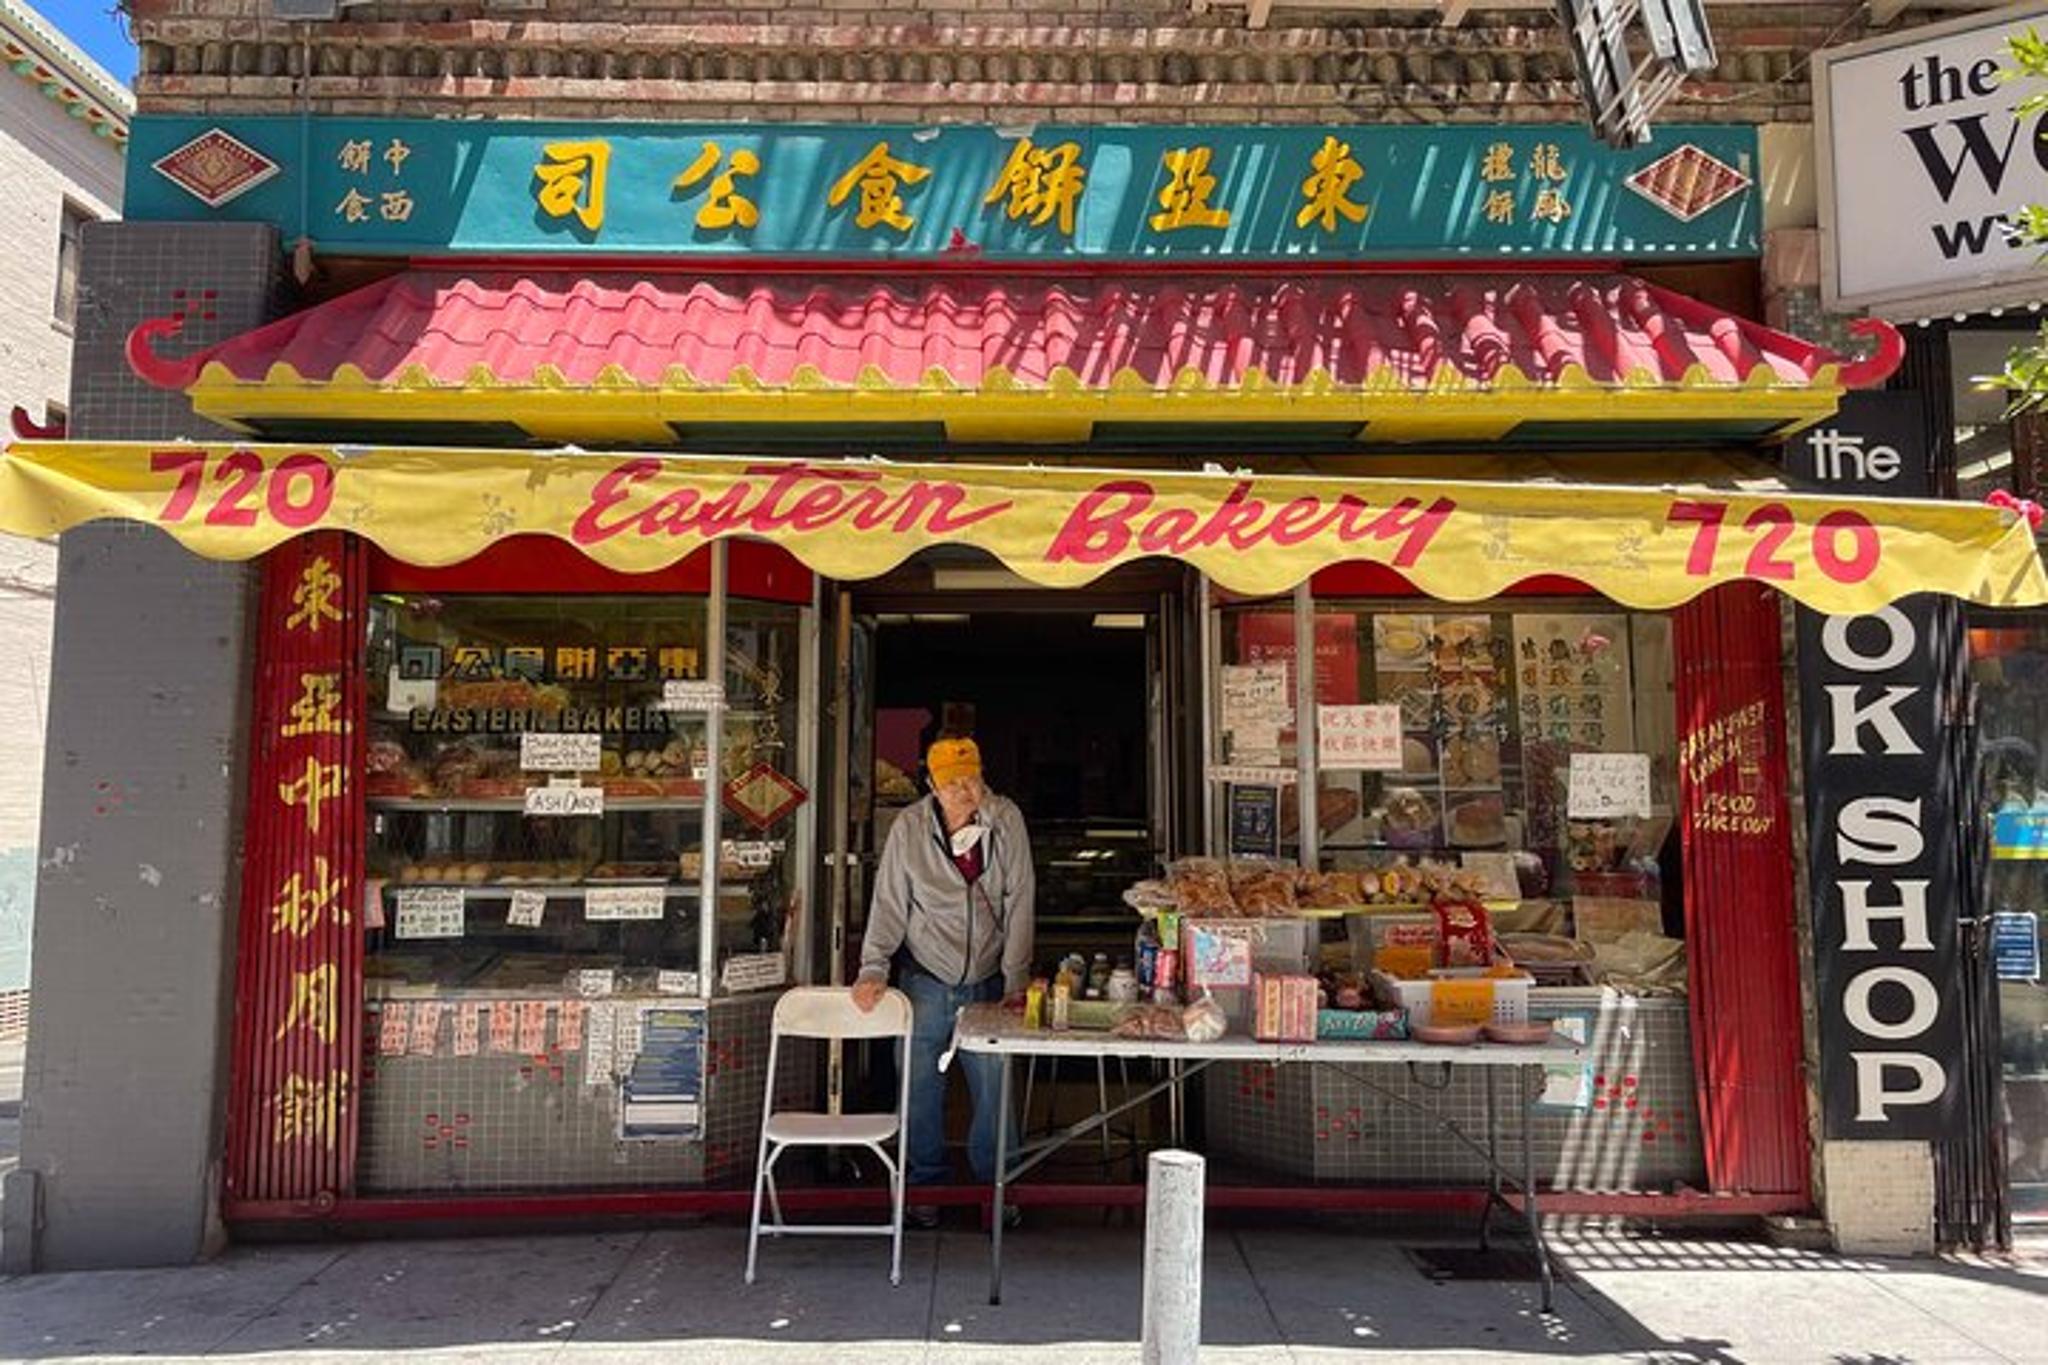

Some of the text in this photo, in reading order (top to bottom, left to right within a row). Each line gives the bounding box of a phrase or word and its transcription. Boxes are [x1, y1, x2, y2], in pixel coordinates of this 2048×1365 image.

[1899, 55, 2000, 111] the
[1806, 429, 1901, 481] the
[149, 450, 335, 529] 720
[570, 457, 1014, 546] Eastern
[1043, 479, 1457, 568] Bakery
[1666, 500, 1882, 585] 720
[408, 706, 676, 735] EASTERN BAKERY
[1821, 603, 1948, 1122] OK SHOP
